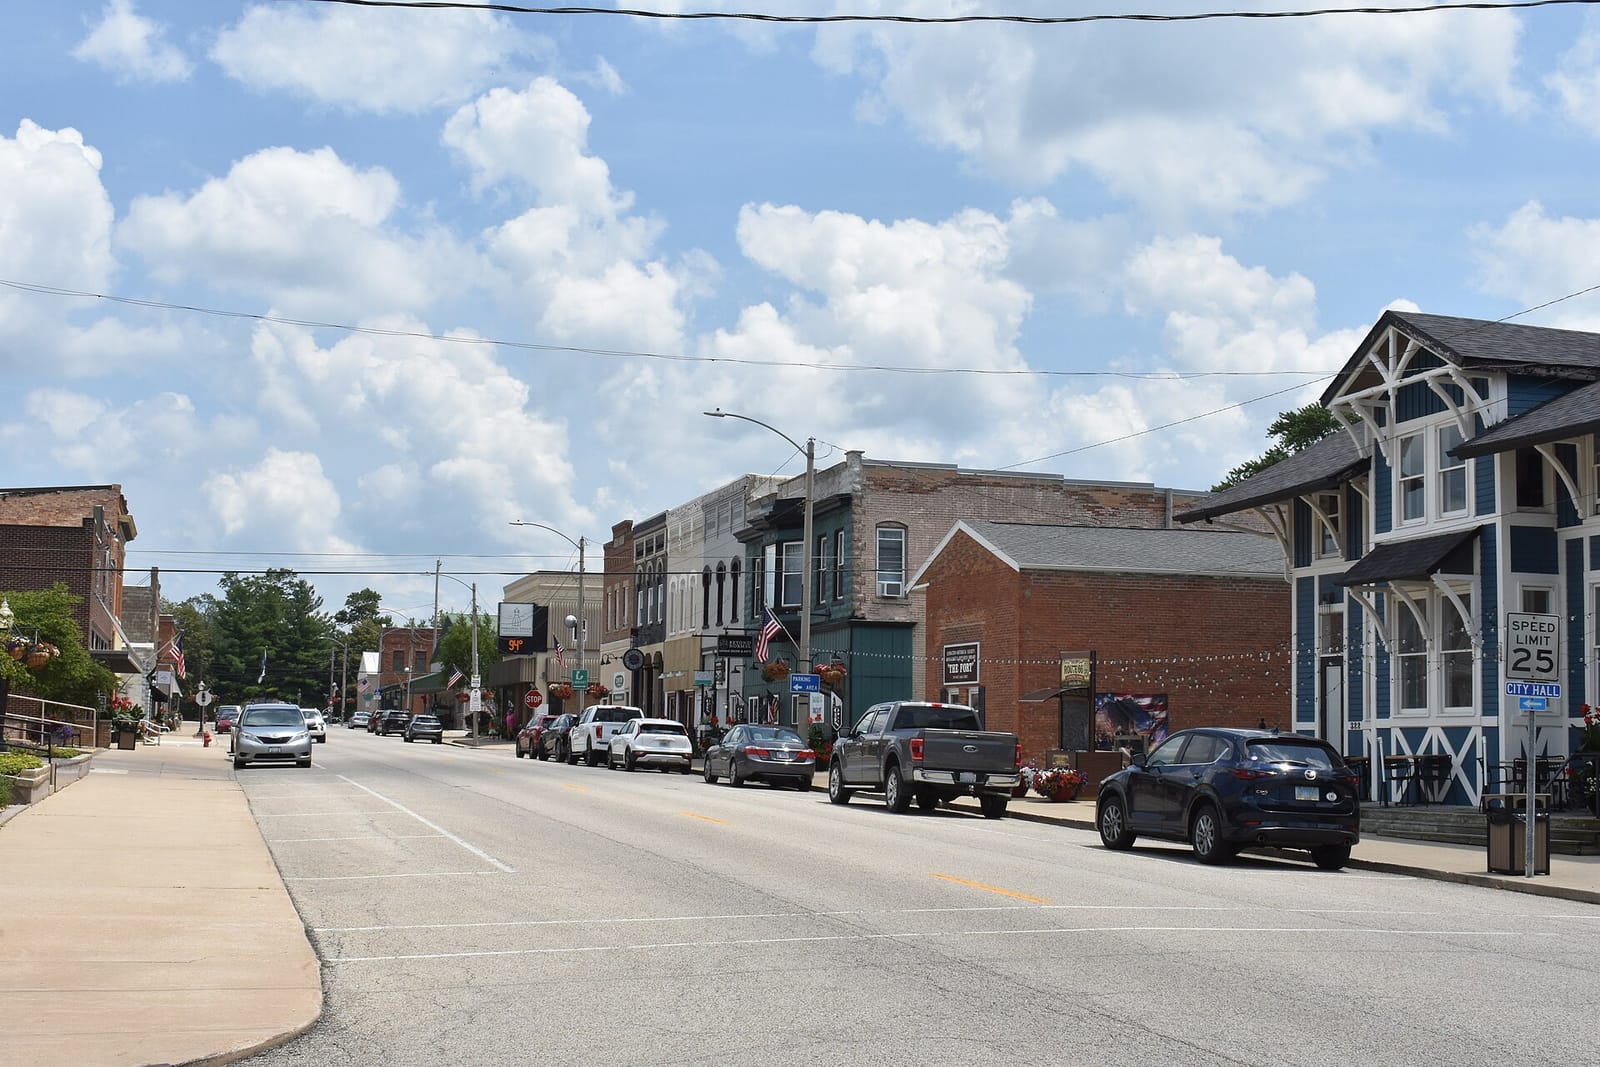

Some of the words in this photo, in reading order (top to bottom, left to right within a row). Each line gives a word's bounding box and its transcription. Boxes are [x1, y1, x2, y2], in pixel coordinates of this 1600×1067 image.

[1512, 620, 1556, 633] SPEED
[1516, 634, 1551, 646] LIMIT
[1512, 648, 1554, 673] 25
[1507, 684, 1529, 695] CITY
[1533, 685, 1559, 697] HALL
[526, 695, 542, 703] STOP
